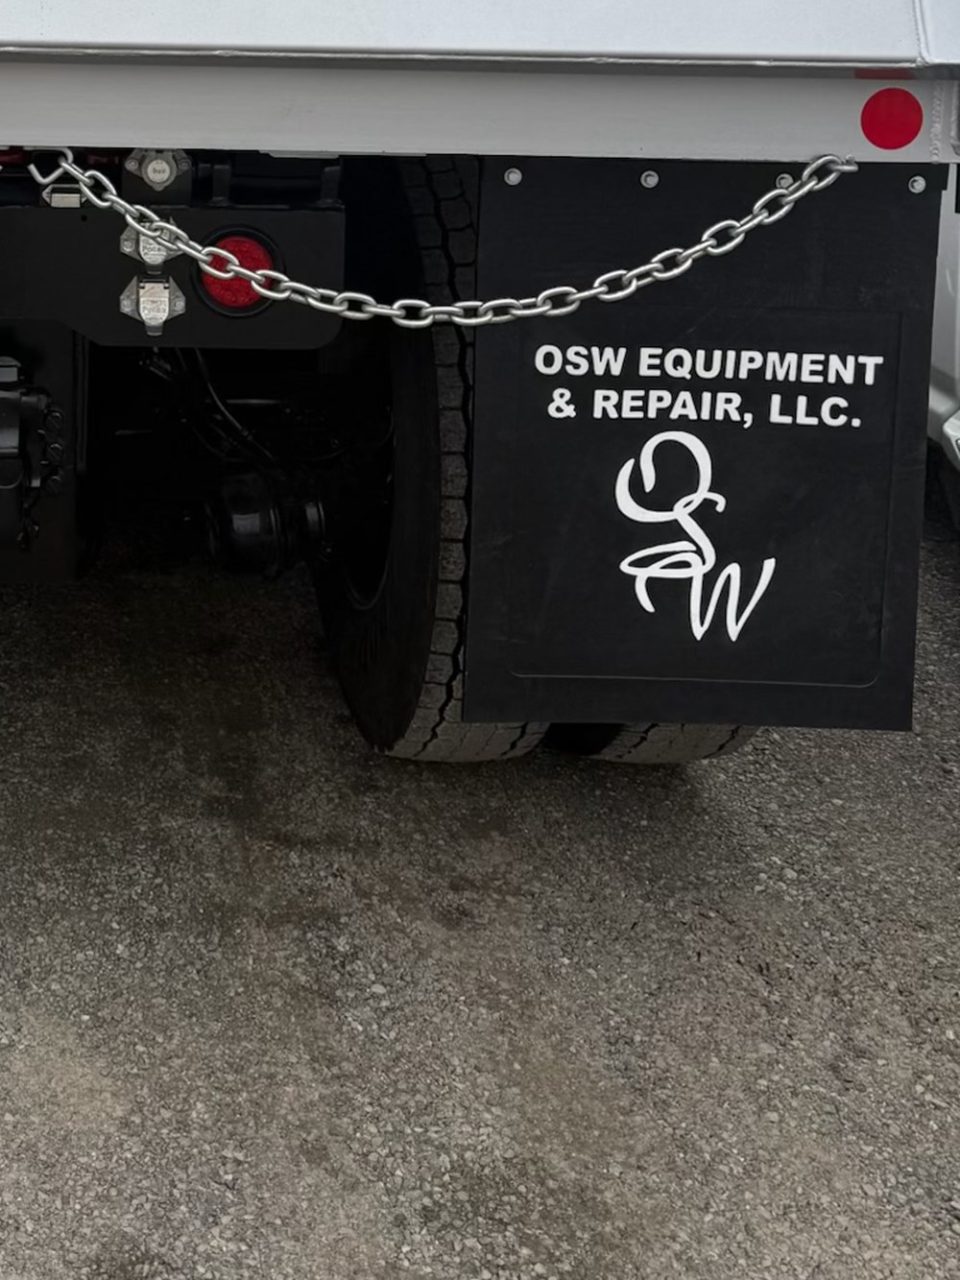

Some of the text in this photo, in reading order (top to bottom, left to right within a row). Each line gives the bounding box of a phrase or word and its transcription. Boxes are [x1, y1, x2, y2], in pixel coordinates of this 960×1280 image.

[535, 345, 883, 385] OSW EQUIPMENT
[548, 388, 860, 428] & REPAIR, LLC.
